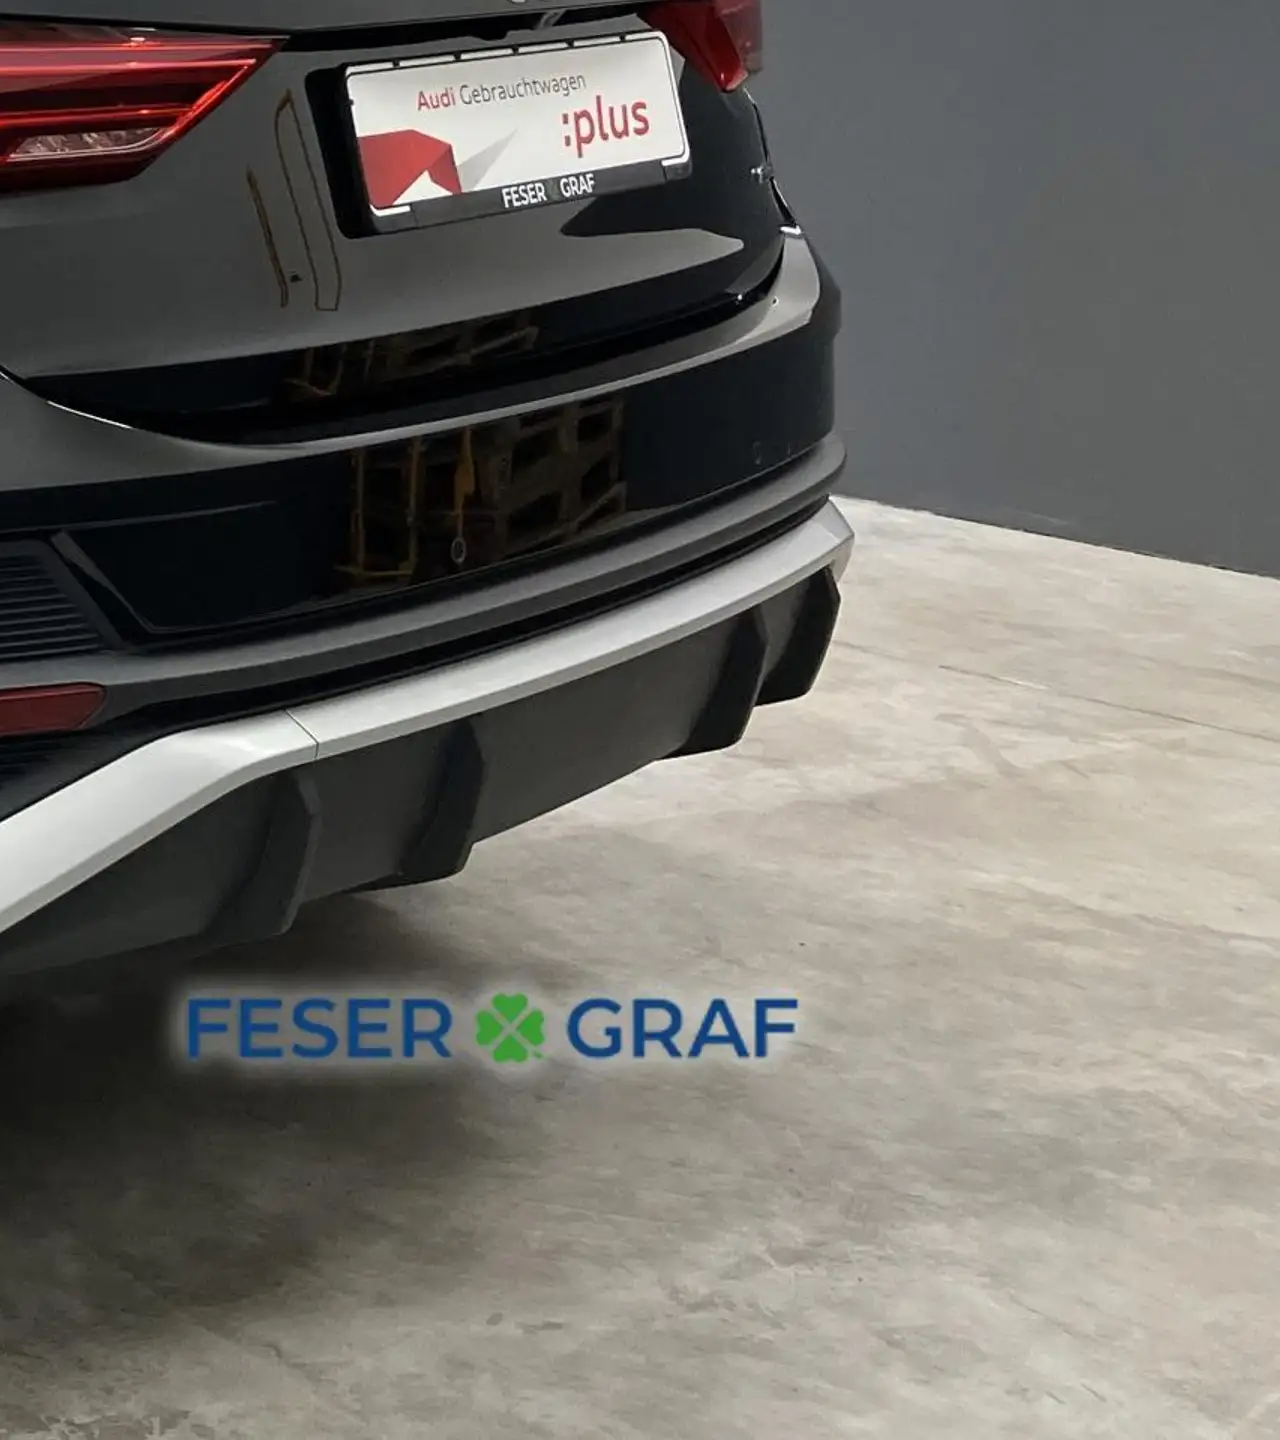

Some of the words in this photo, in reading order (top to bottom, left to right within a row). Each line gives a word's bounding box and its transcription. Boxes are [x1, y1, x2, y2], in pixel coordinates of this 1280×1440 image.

[416, 87, 456, 111] Audi
[459, 72, 587, 105] Gebrauchtwagen
[562, 95, 650, 158] :plus
[501, 182, 547, 209] FESER
[559, 173, 596, 199] GRAF
